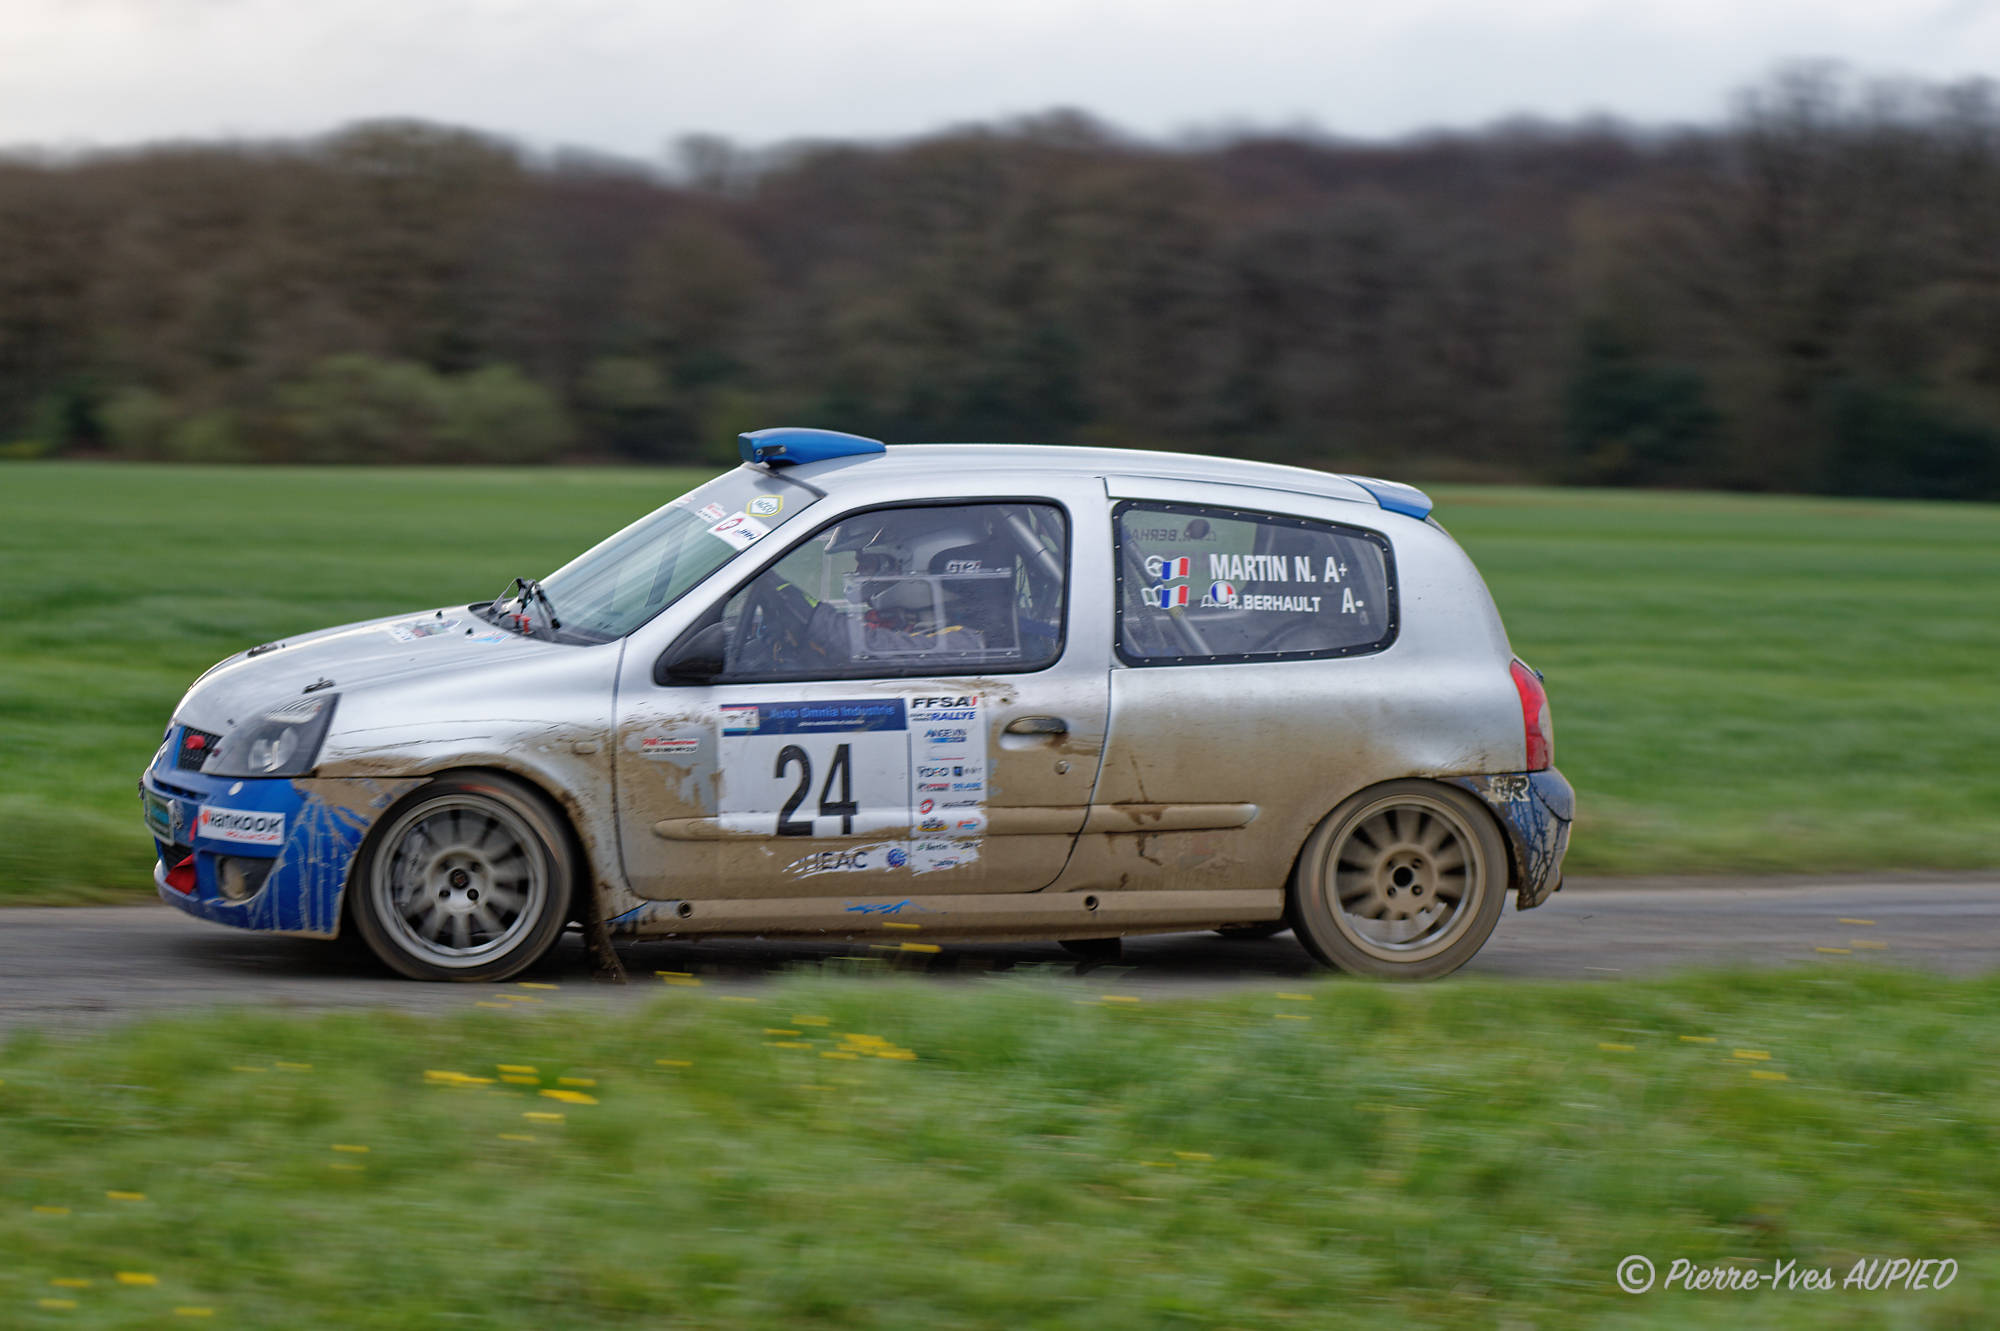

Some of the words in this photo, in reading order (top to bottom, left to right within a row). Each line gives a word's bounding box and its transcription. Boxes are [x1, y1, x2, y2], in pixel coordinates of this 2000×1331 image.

[1209, 553, 1288, 582] MARTIN
[1295, 556, 1317, 583] N.
[1323, 556, 1348, 583] A+
[911, 696, 969, 709] FFSA
[931, 711, 977, 721] RALLYE
[773, 743, 858, 836] 24
